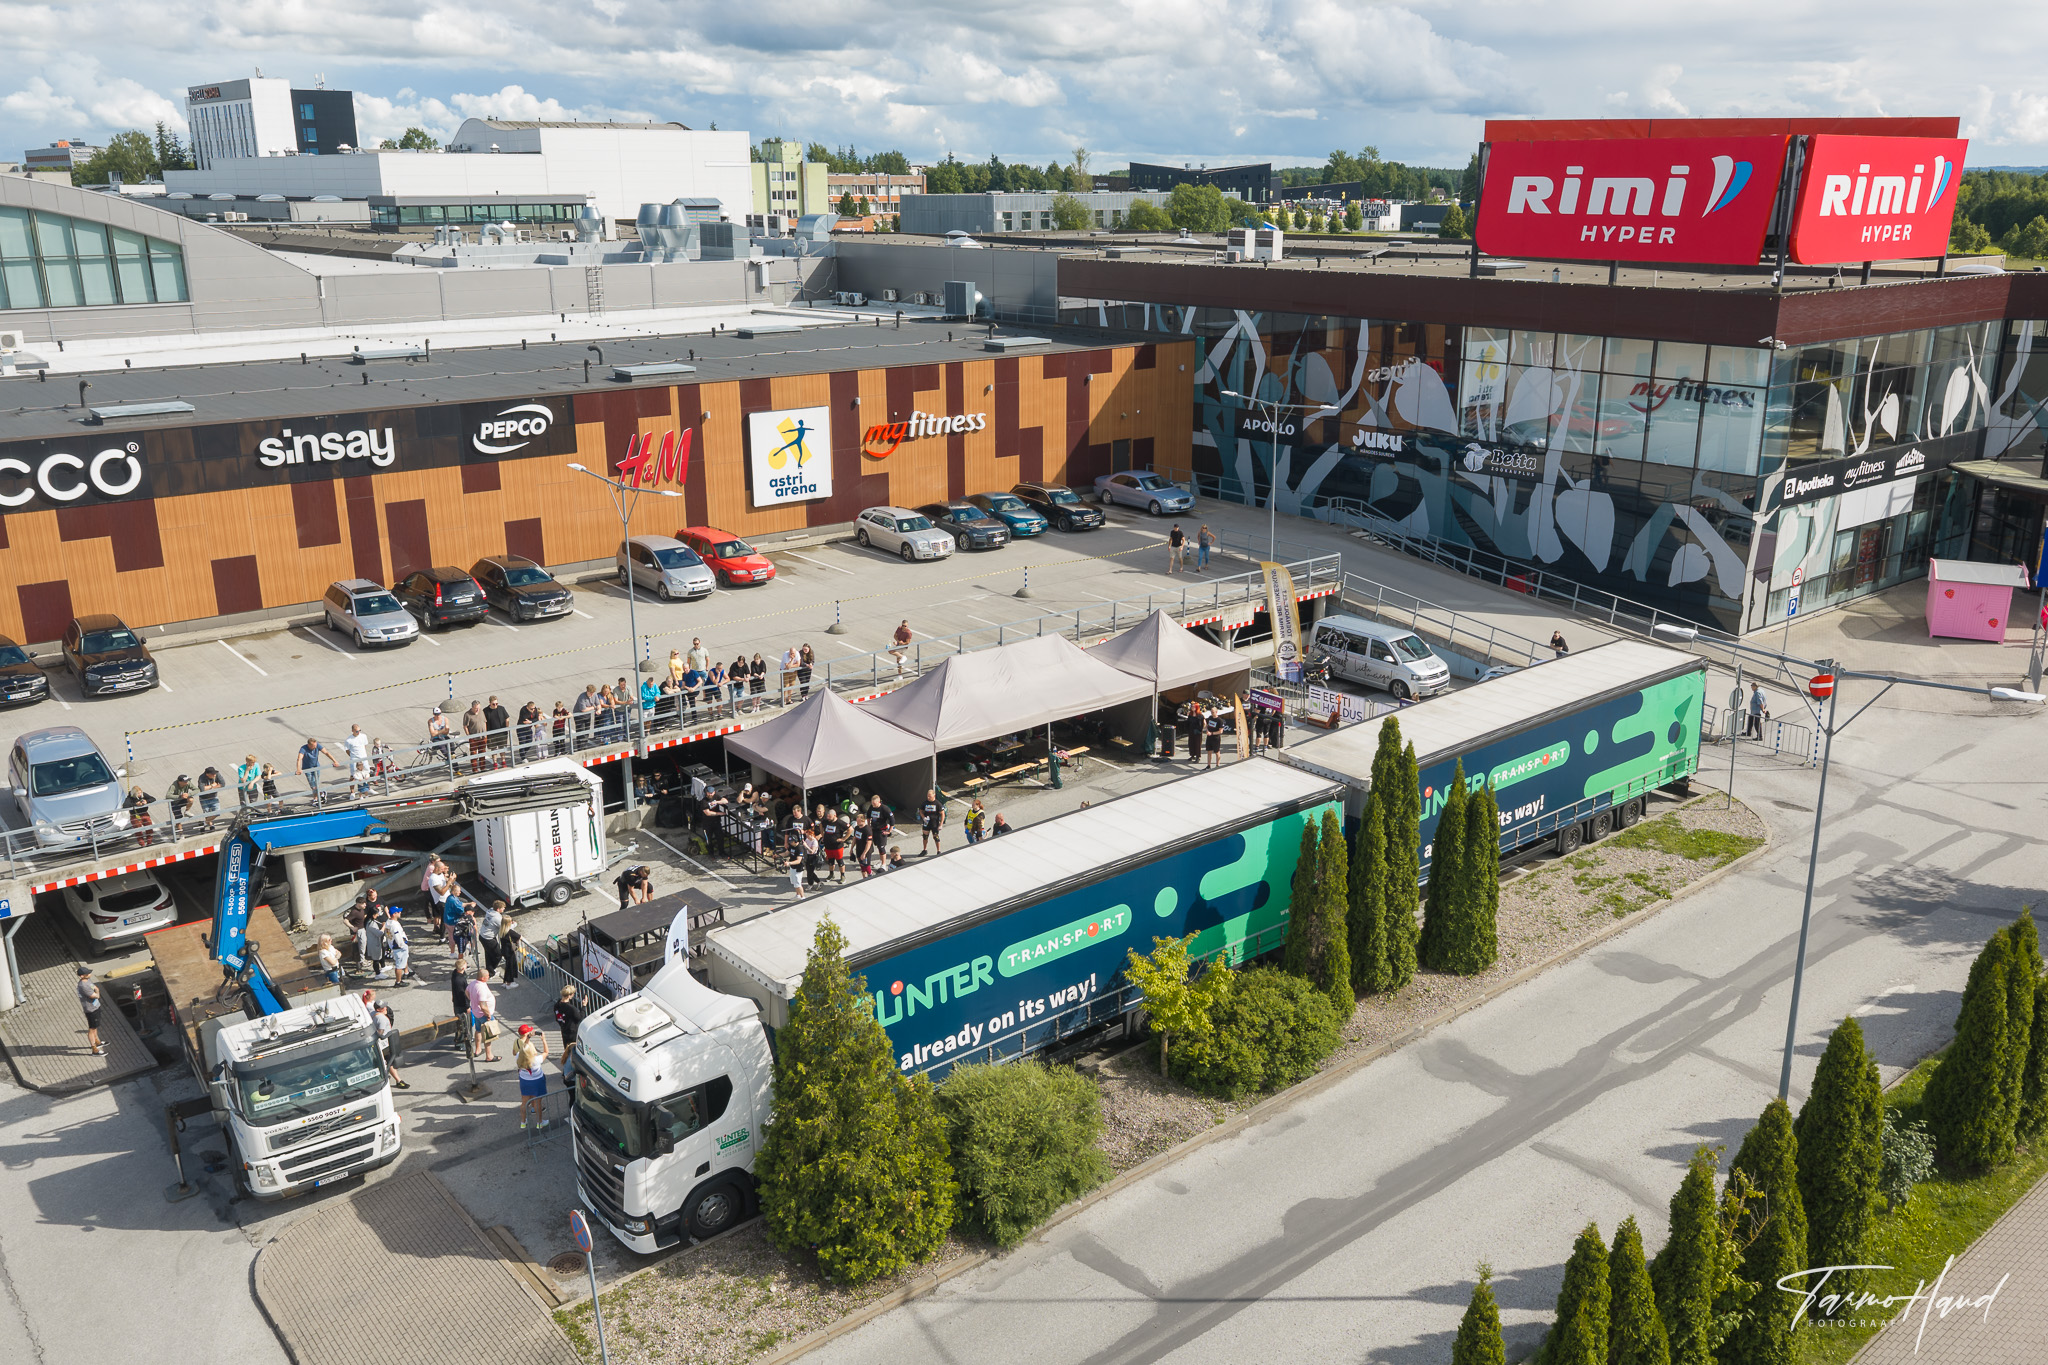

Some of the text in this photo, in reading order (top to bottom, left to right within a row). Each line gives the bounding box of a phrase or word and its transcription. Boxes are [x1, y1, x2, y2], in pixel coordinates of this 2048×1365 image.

[1506, 165, 1690, 217] Rimi
[1819, 163, 1924, 217] Rimi
[1580, 225, 1676, 244] HYPER
[1861, 224, 1911, 243] HYPER
[480, 417, 547, 440] PEPCO
[1243, 418, 1295, 435] APOLLO
[260, 427, 396, 467] sinsay
[615, 427, 693, 488] H&M
[1491, 449, 1536, 470] Betta
[769, 472, 803, 488] astri
[775, 483, 817, 498] arena
[1796, 474, 1834, 496] Apotheka
[1514, 794, 1545, 823] way!
[230, 846, 241, 879] FASSI
[874, 955, 994, 1028] LiNTER
[900, 973, 1098, 1071] already on its way!
